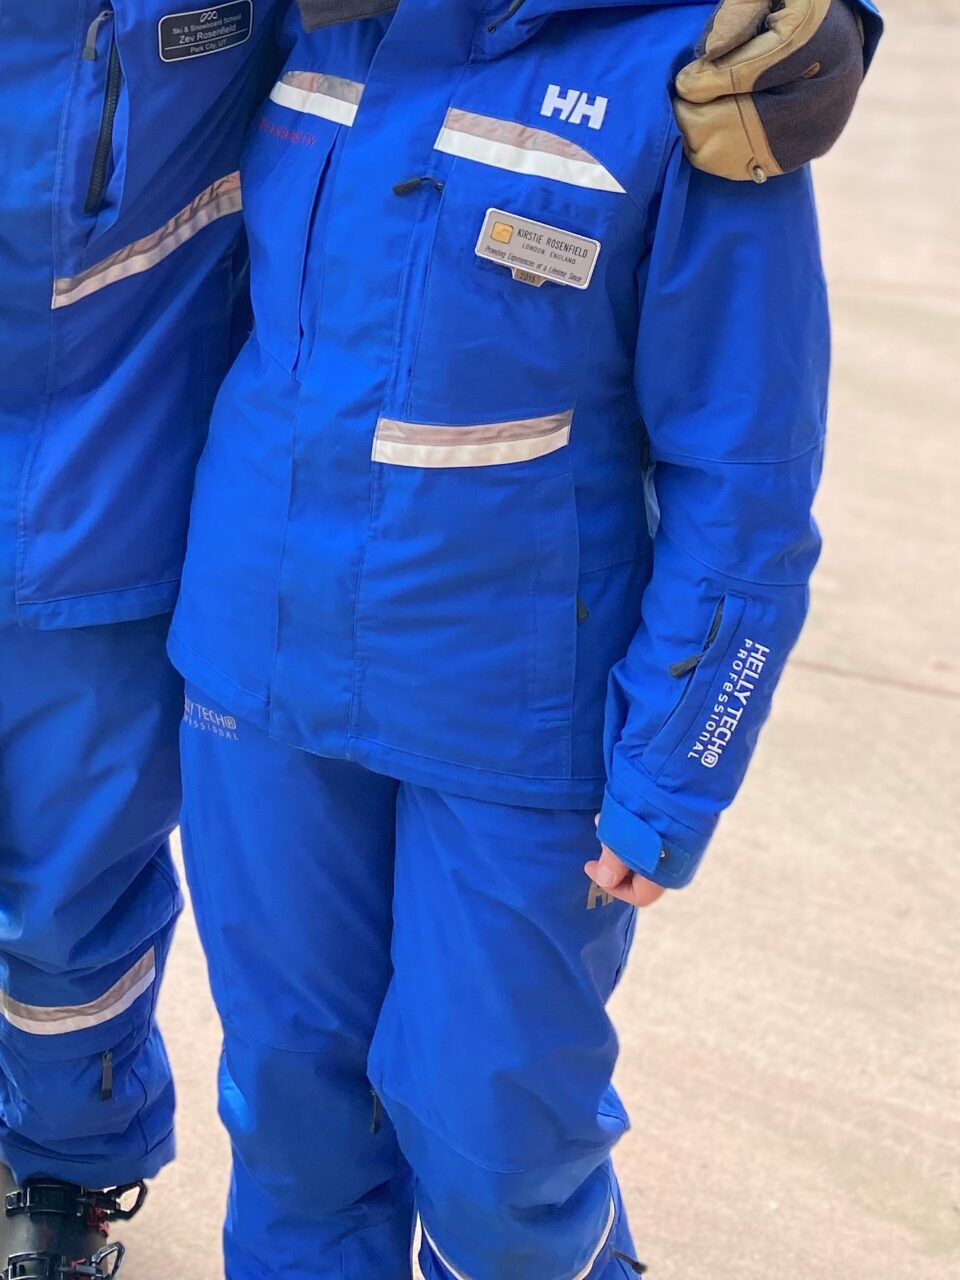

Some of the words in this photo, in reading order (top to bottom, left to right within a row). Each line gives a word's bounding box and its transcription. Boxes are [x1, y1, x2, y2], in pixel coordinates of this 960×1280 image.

[178, 34, 195, 44] Zev
[196, 24, 237, 40] Rosenfield
[540, 84, 608, 130] HH
[517, 227, 544, 245] KIRSTIE
[546, 236, 589, 259] ROSENFIELD
[549, 251, 577, 265] ENGLAND
[733, 643, 770, 706] HELLY
